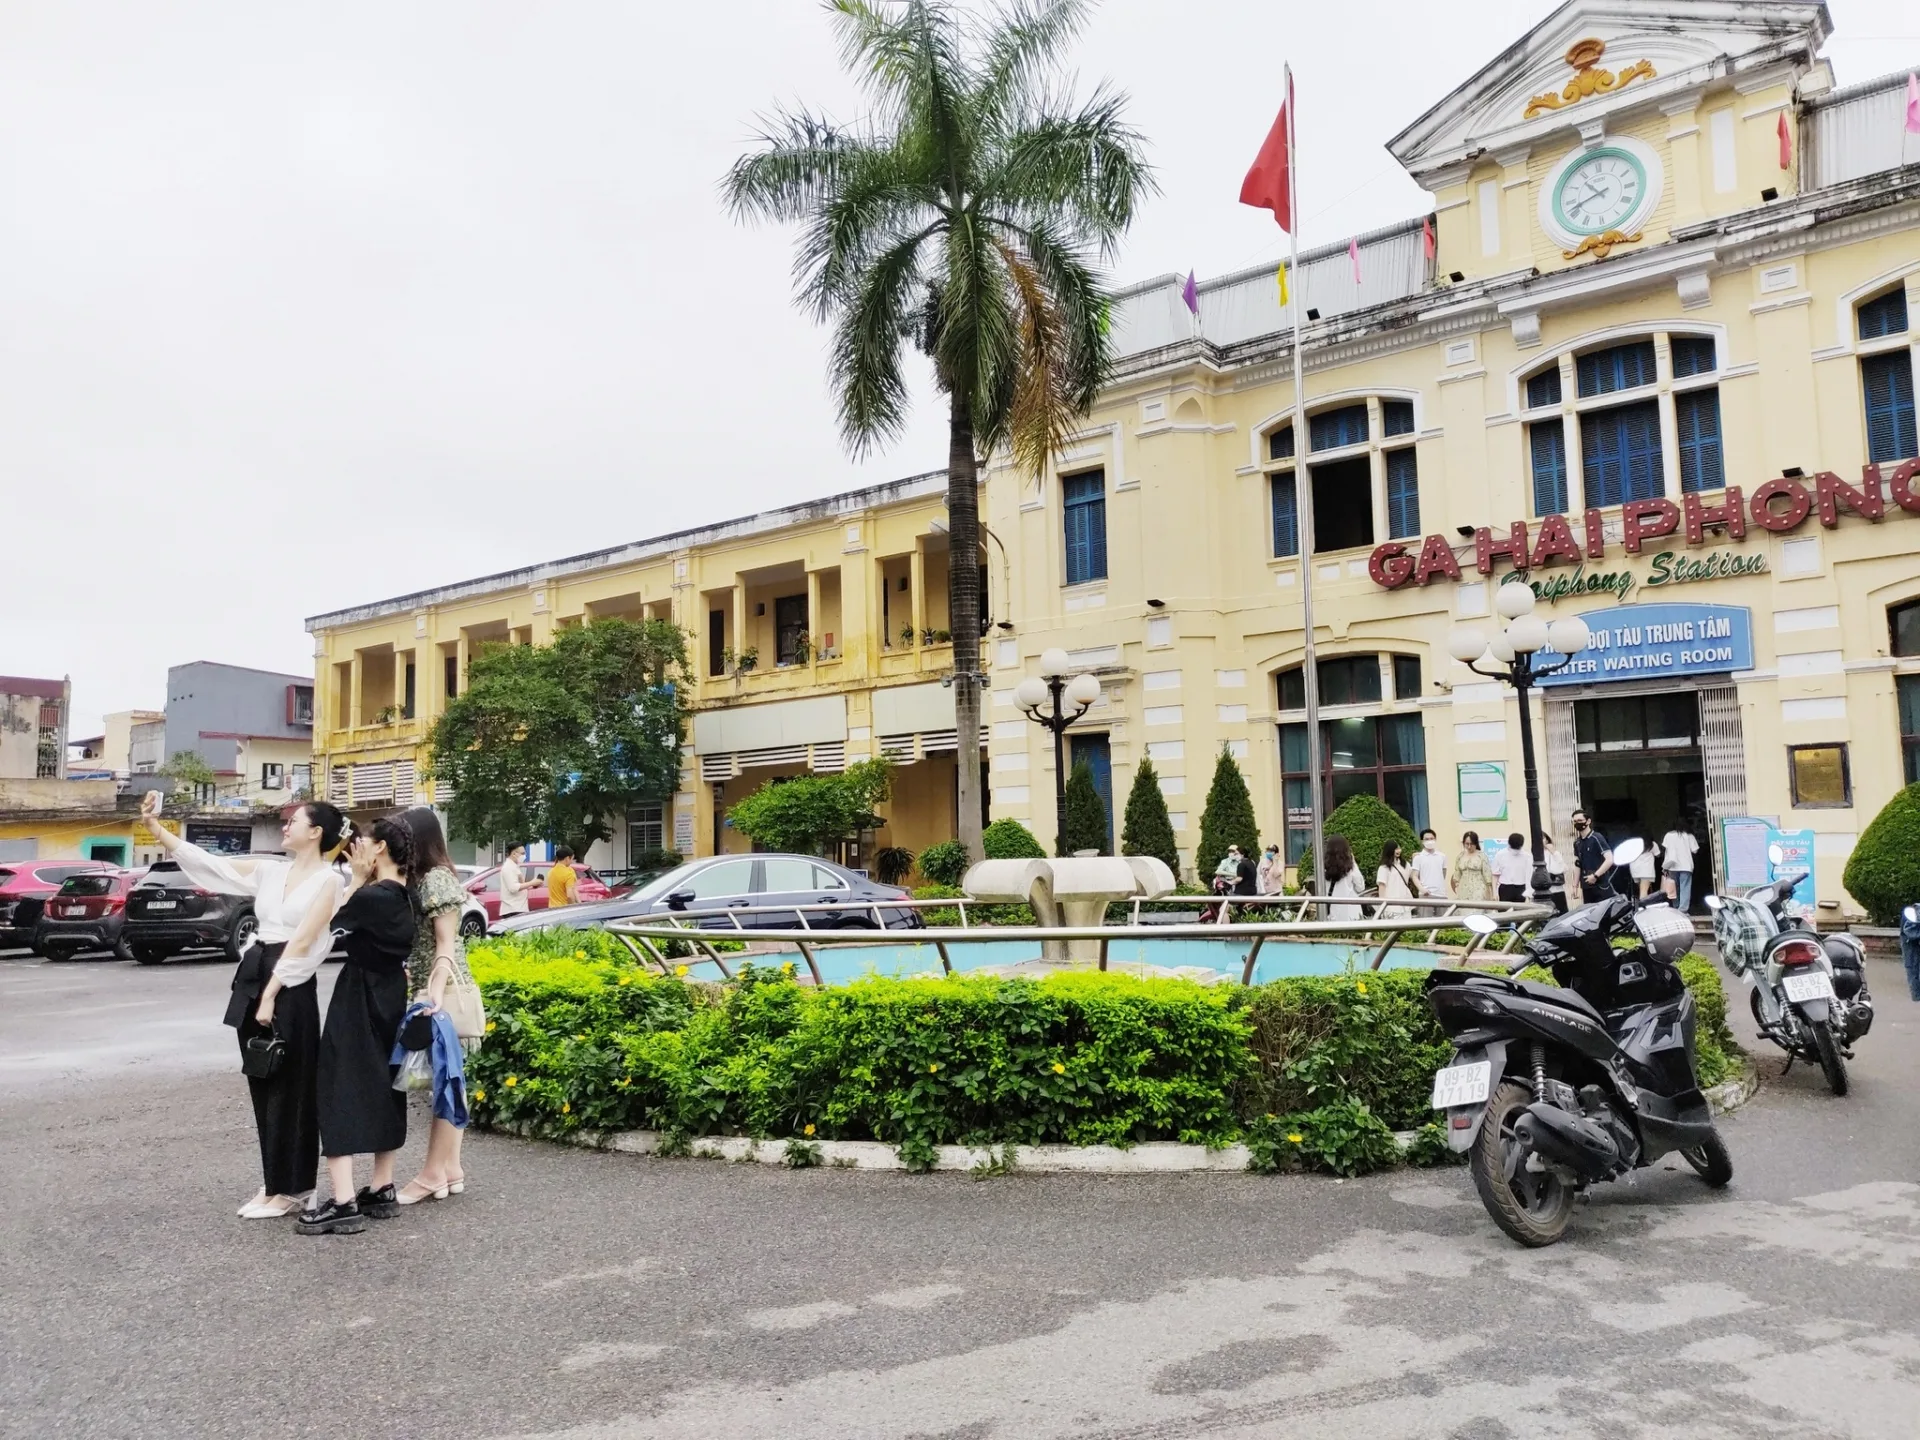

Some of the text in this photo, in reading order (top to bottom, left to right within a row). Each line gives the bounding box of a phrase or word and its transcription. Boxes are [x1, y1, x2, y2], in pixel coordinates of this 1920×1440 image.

[1368, 533, 1462, 588] GA
[1475, 508, 1604, 574] HAI
[1647, 550, 1766, 587] Station
[1588, 629, 1610, 652] ĐỢI
[1614, 623, 1641, 647] TÀU
[1645, 620, 1694, 645] TRUNG
[1698, 615, 1731, 639] TÂM
[1603, 652, 1673, 671] WAITING
[1681, 646, 1732, 665] ROOM
[1790, 974, 1823, 989] 89-B2
[1444, 1066, 1482, 1087] 89-B2
[1440, 1082, 1485, 1105] 171.19
